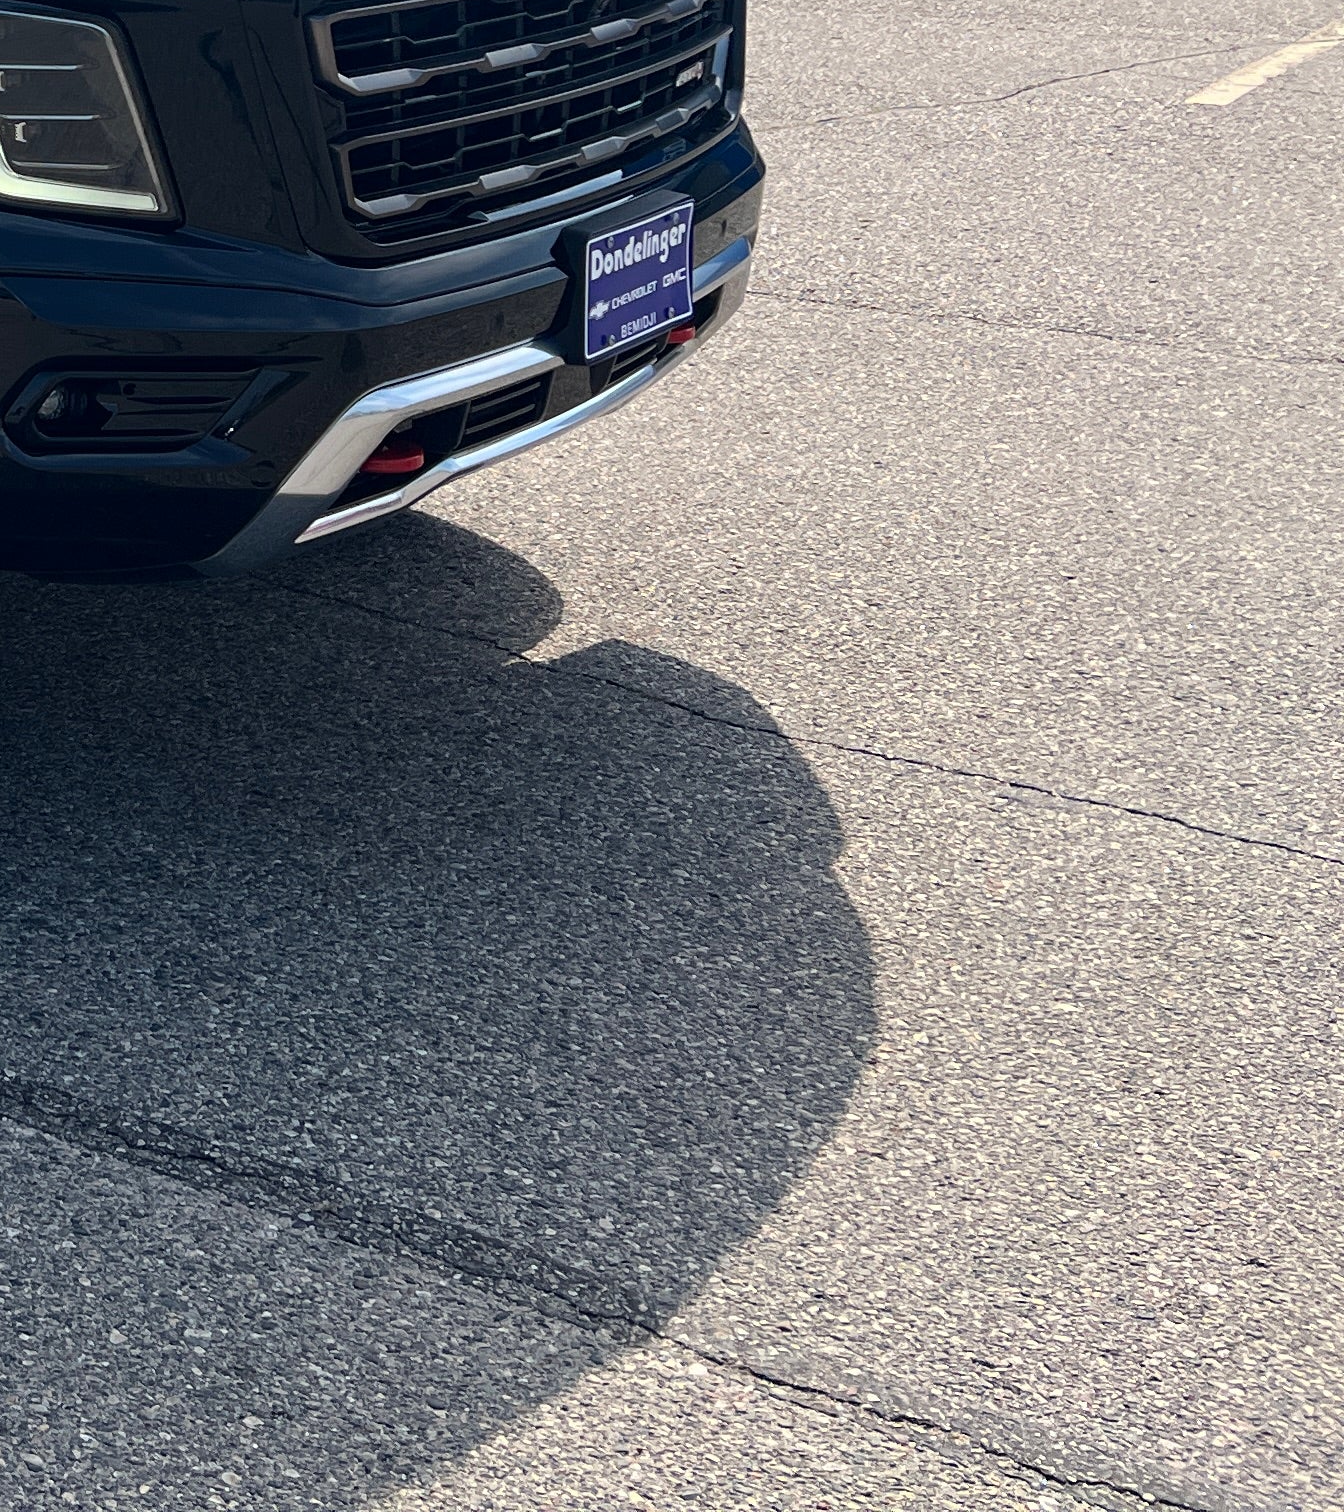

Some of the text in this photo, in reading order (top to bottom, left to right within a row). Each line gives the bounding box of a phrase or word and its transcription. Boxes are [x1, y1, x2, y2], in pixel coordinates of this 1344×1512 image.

[590, 223, 687, 281] Dondelinger
[611, 267, 687, 309] CHEVROLET GMC
[620, 311, 657, 338] BEMIDJI
